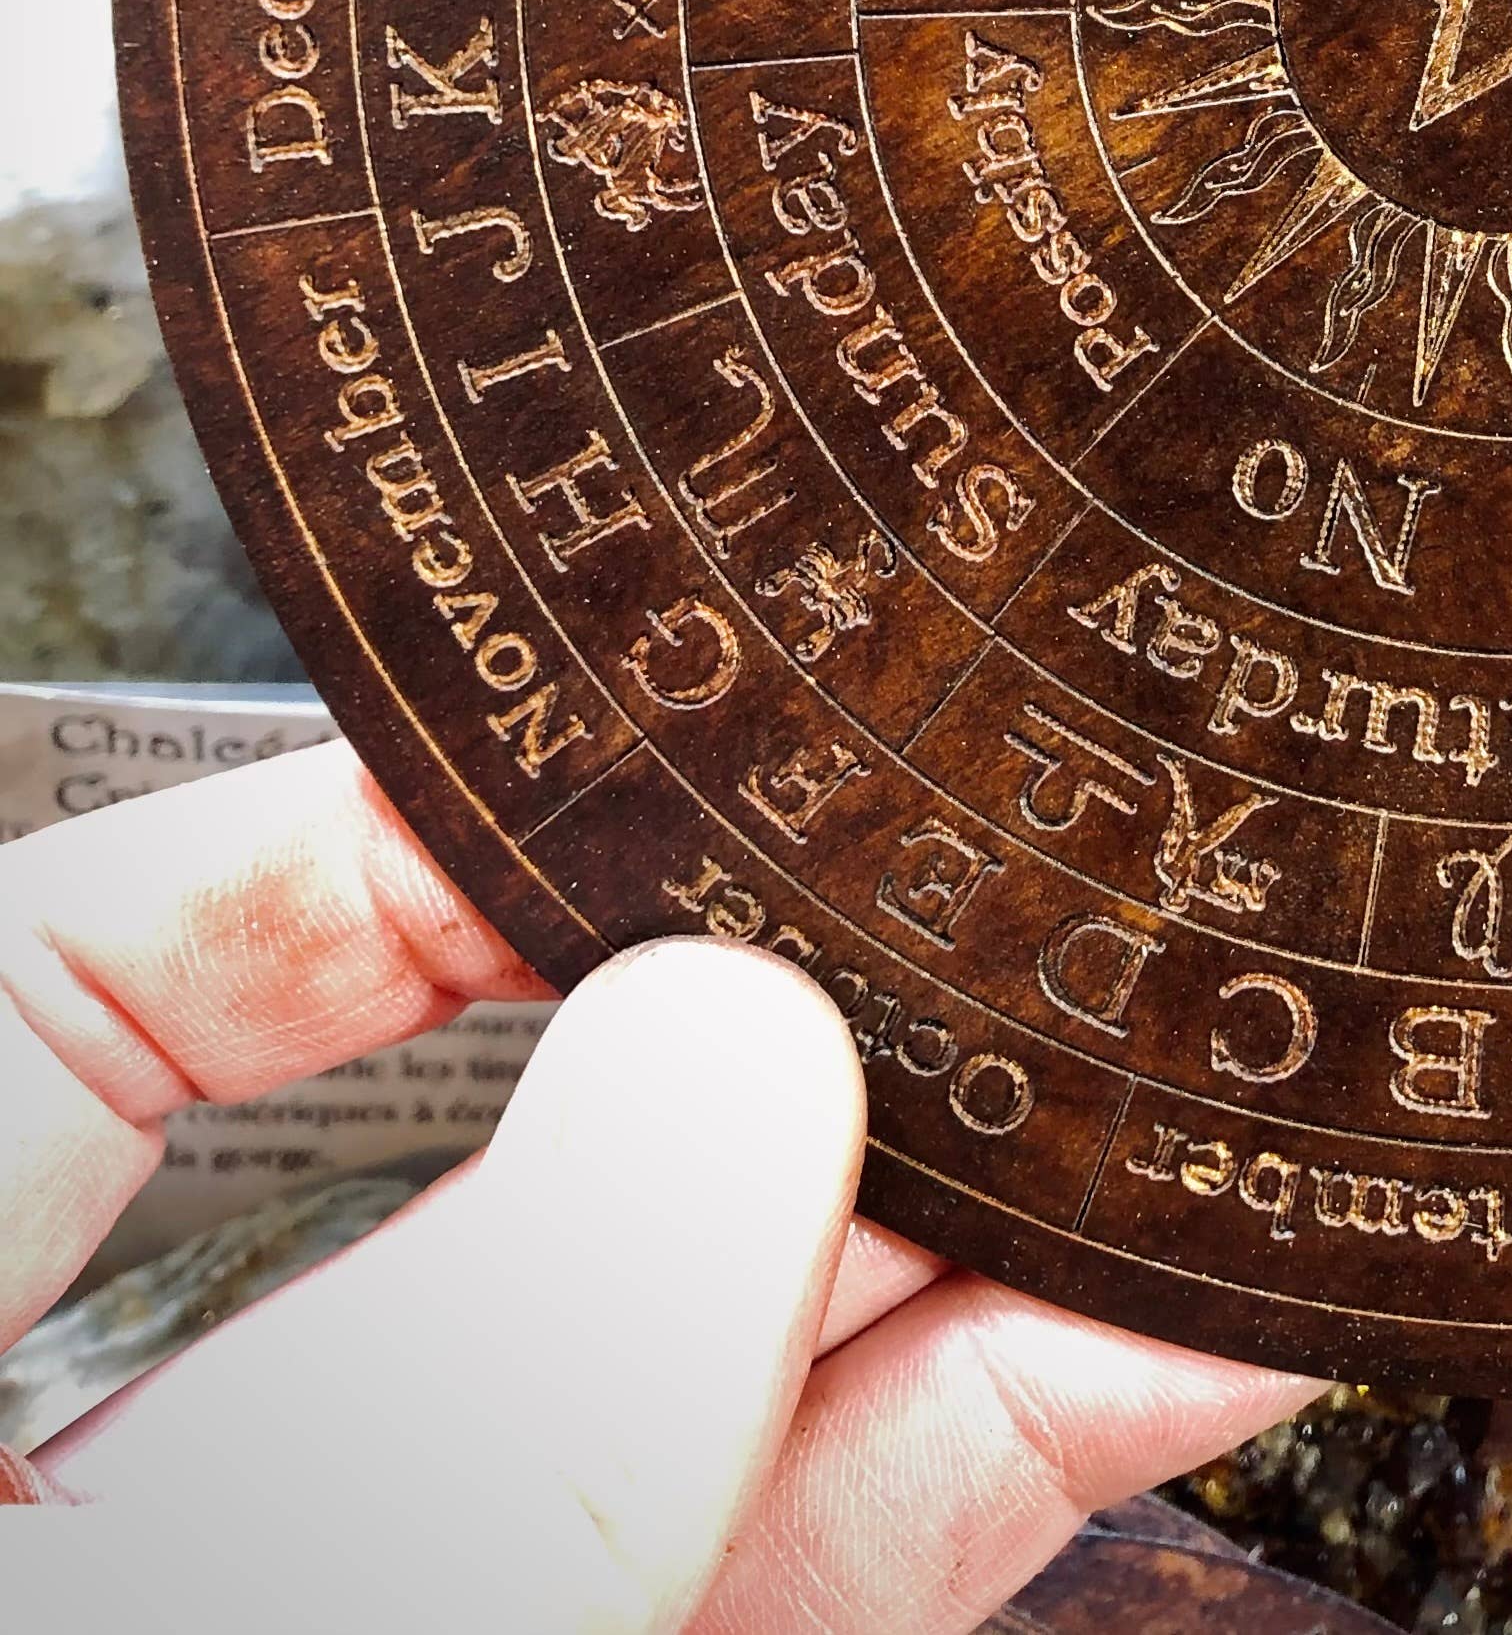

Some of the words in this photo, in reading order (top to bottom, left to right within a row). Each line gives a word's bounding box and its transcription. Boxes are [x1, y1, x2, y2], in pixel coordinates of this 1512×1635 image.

[385, 15, 503, 130] K
[410, 203, 534, 284] J
[947, 30, 1161, 393] Possibly
[457, 328, 572, 405] I
[749, 90, 1036, 563] Sunday
[297, 273, 594, 778] November
[505, 429, 653, 573] H
[1231, 438, 1442, 596] No
[620, 594, 743, 711] G
[737, 740, 873, 846] F
[876, 814, 1007, 951] E
[1037, 914, 1167, 1038] D
[1209, 971, 1319, 1084] C
[1388, 1004, 1498, 1120] B
